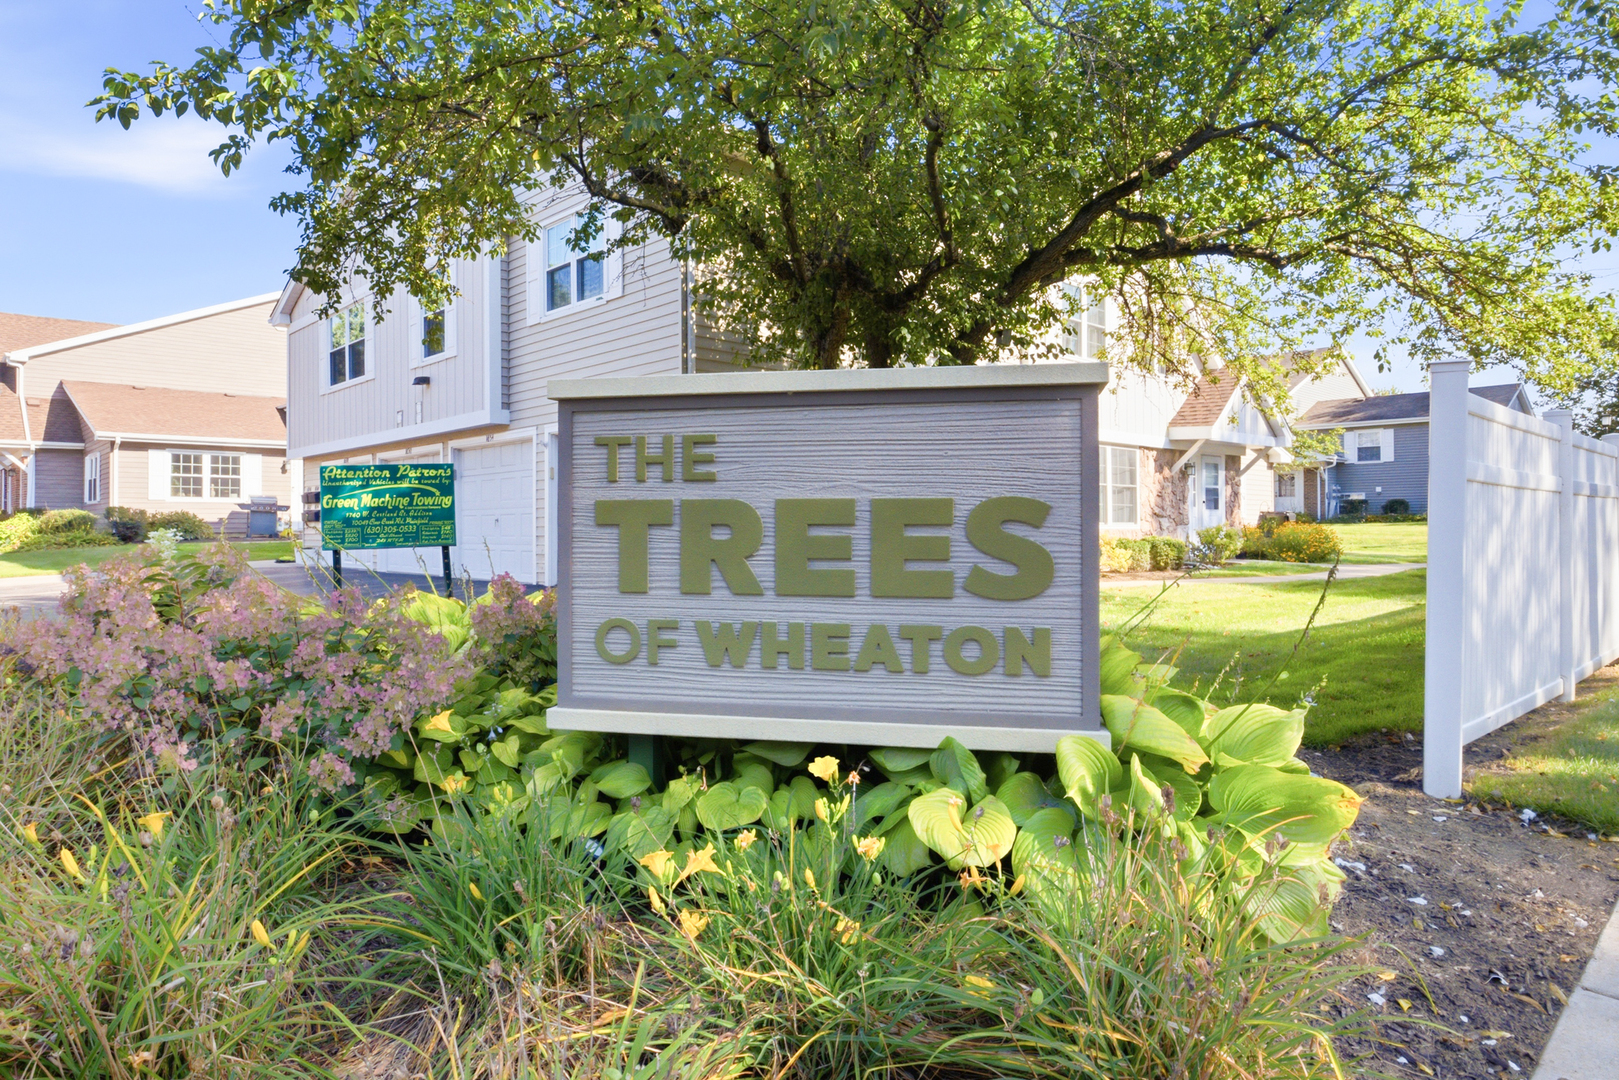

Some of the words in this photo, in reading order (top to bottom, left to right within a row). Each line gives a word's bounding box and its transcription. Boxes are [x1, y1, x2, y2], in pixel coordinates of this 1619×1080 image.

[322, 466, 390, 480] Attention
[594, 433, 717, 482] THE
[322, 479, 367, 487] Unauthorized
[322, 494, 359, 510] Green
[360, 493, 411, 509] Machine
[411, 492, 453, 508] Towing
[594, 496, 1055, 601] TREES
[595, 617, 679, 665] OF
[695, 619, 1052, 678] WHEATON
